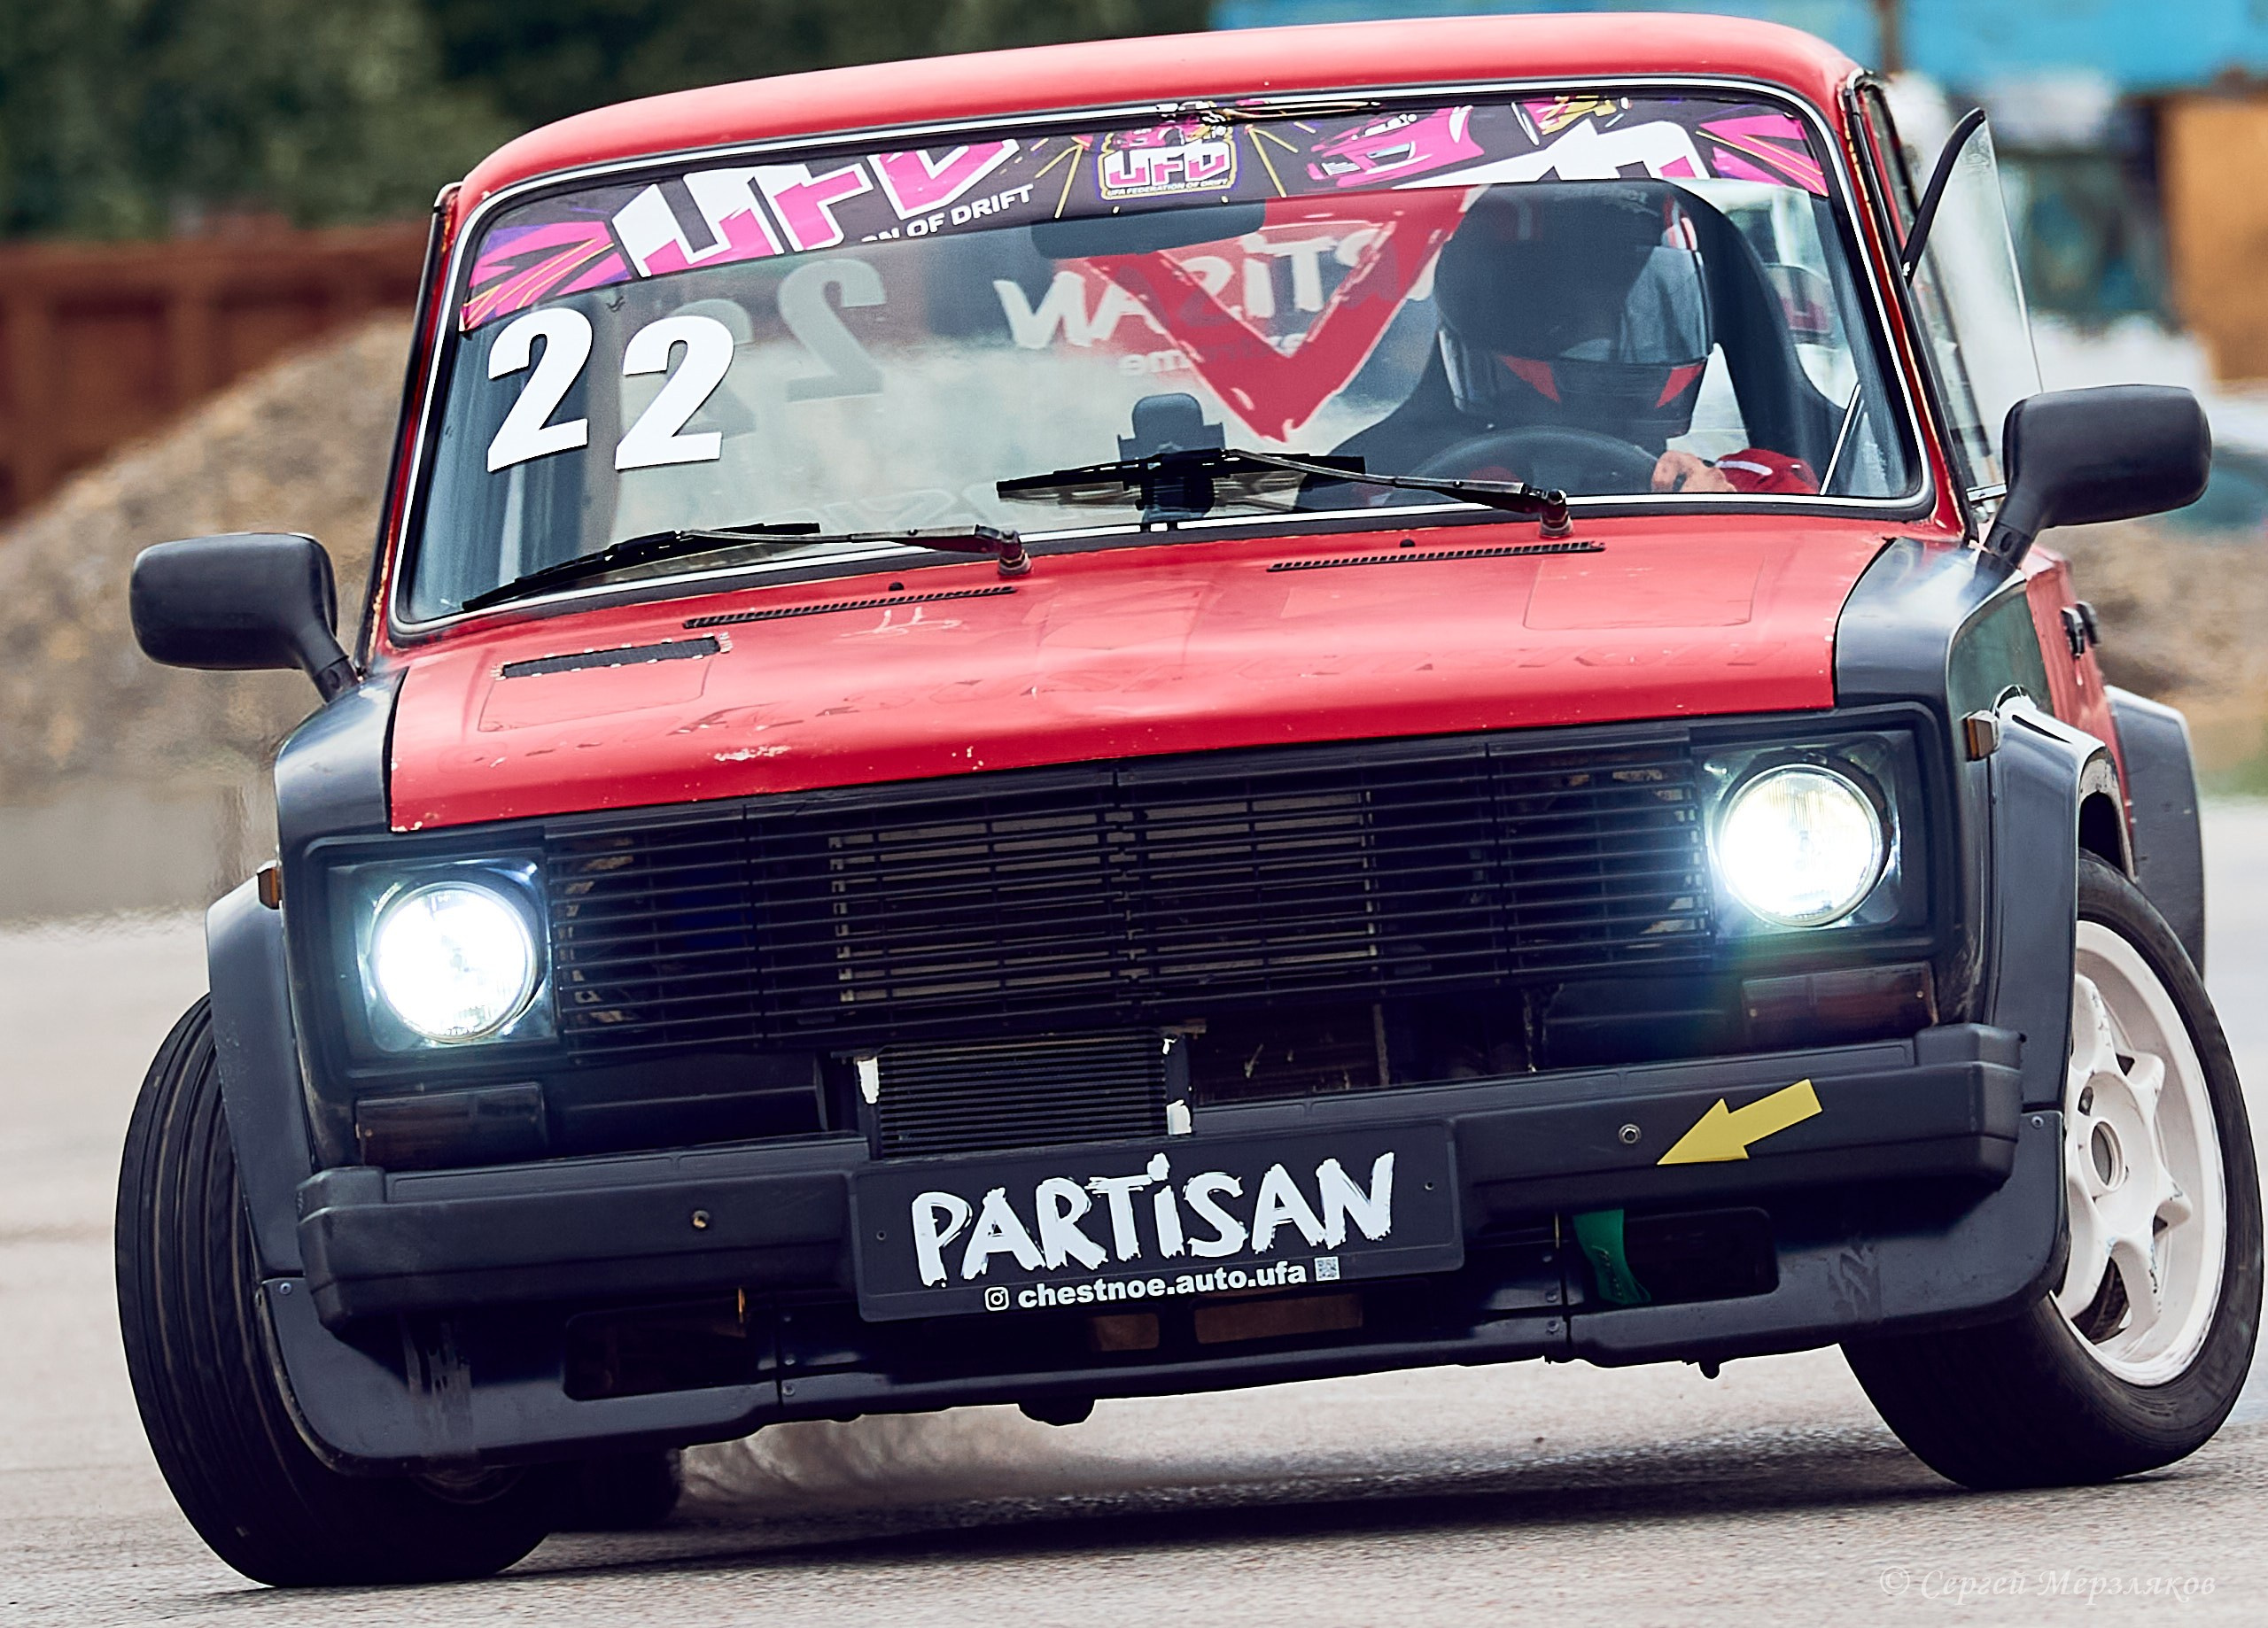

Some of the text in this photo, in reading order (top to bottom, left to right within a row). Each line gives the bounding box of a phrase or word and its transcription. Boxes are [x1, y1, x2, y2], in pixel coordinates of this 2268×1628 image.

[906, 213, 945, 237] OF
[950, 183, 1034, 226] DRIFT
[486, 307, 735, 472] 22
[1016, 1260, 1308, 1309] chestnoe.auto.ufa
